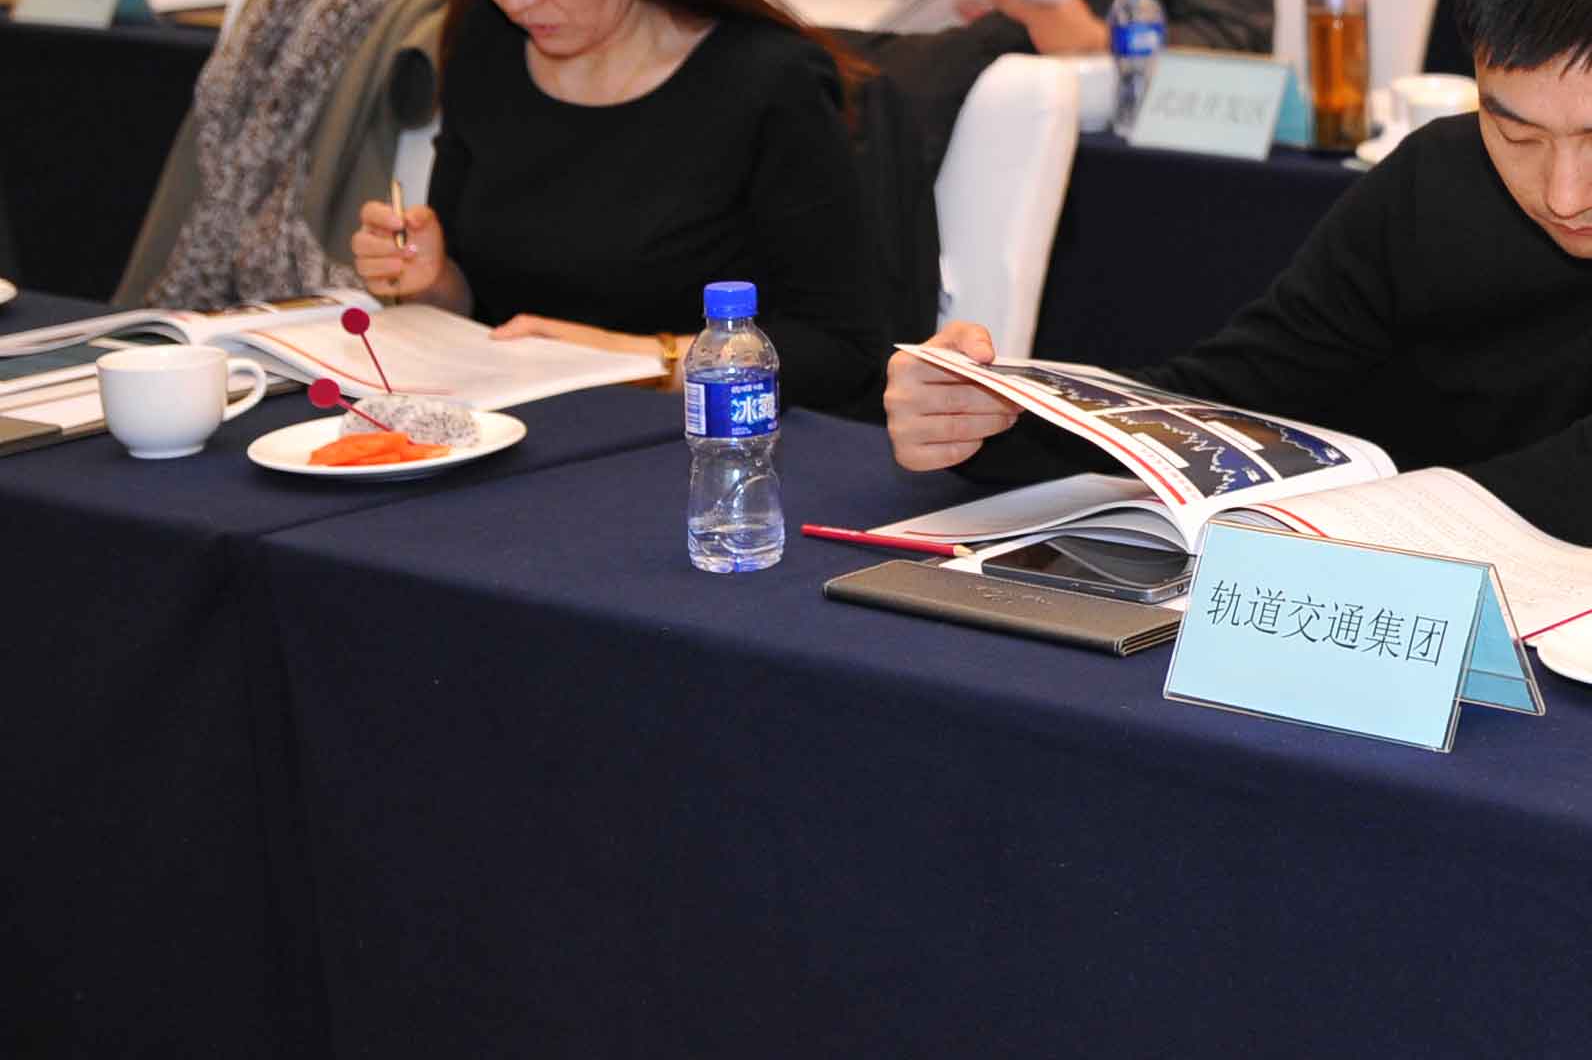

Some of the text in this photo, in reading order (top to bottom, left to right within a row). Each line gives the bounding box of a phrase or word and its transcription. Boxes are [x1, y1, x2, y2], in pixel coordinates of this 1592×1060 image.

[1206, 579, 1449, 667] 轨道交通集团
